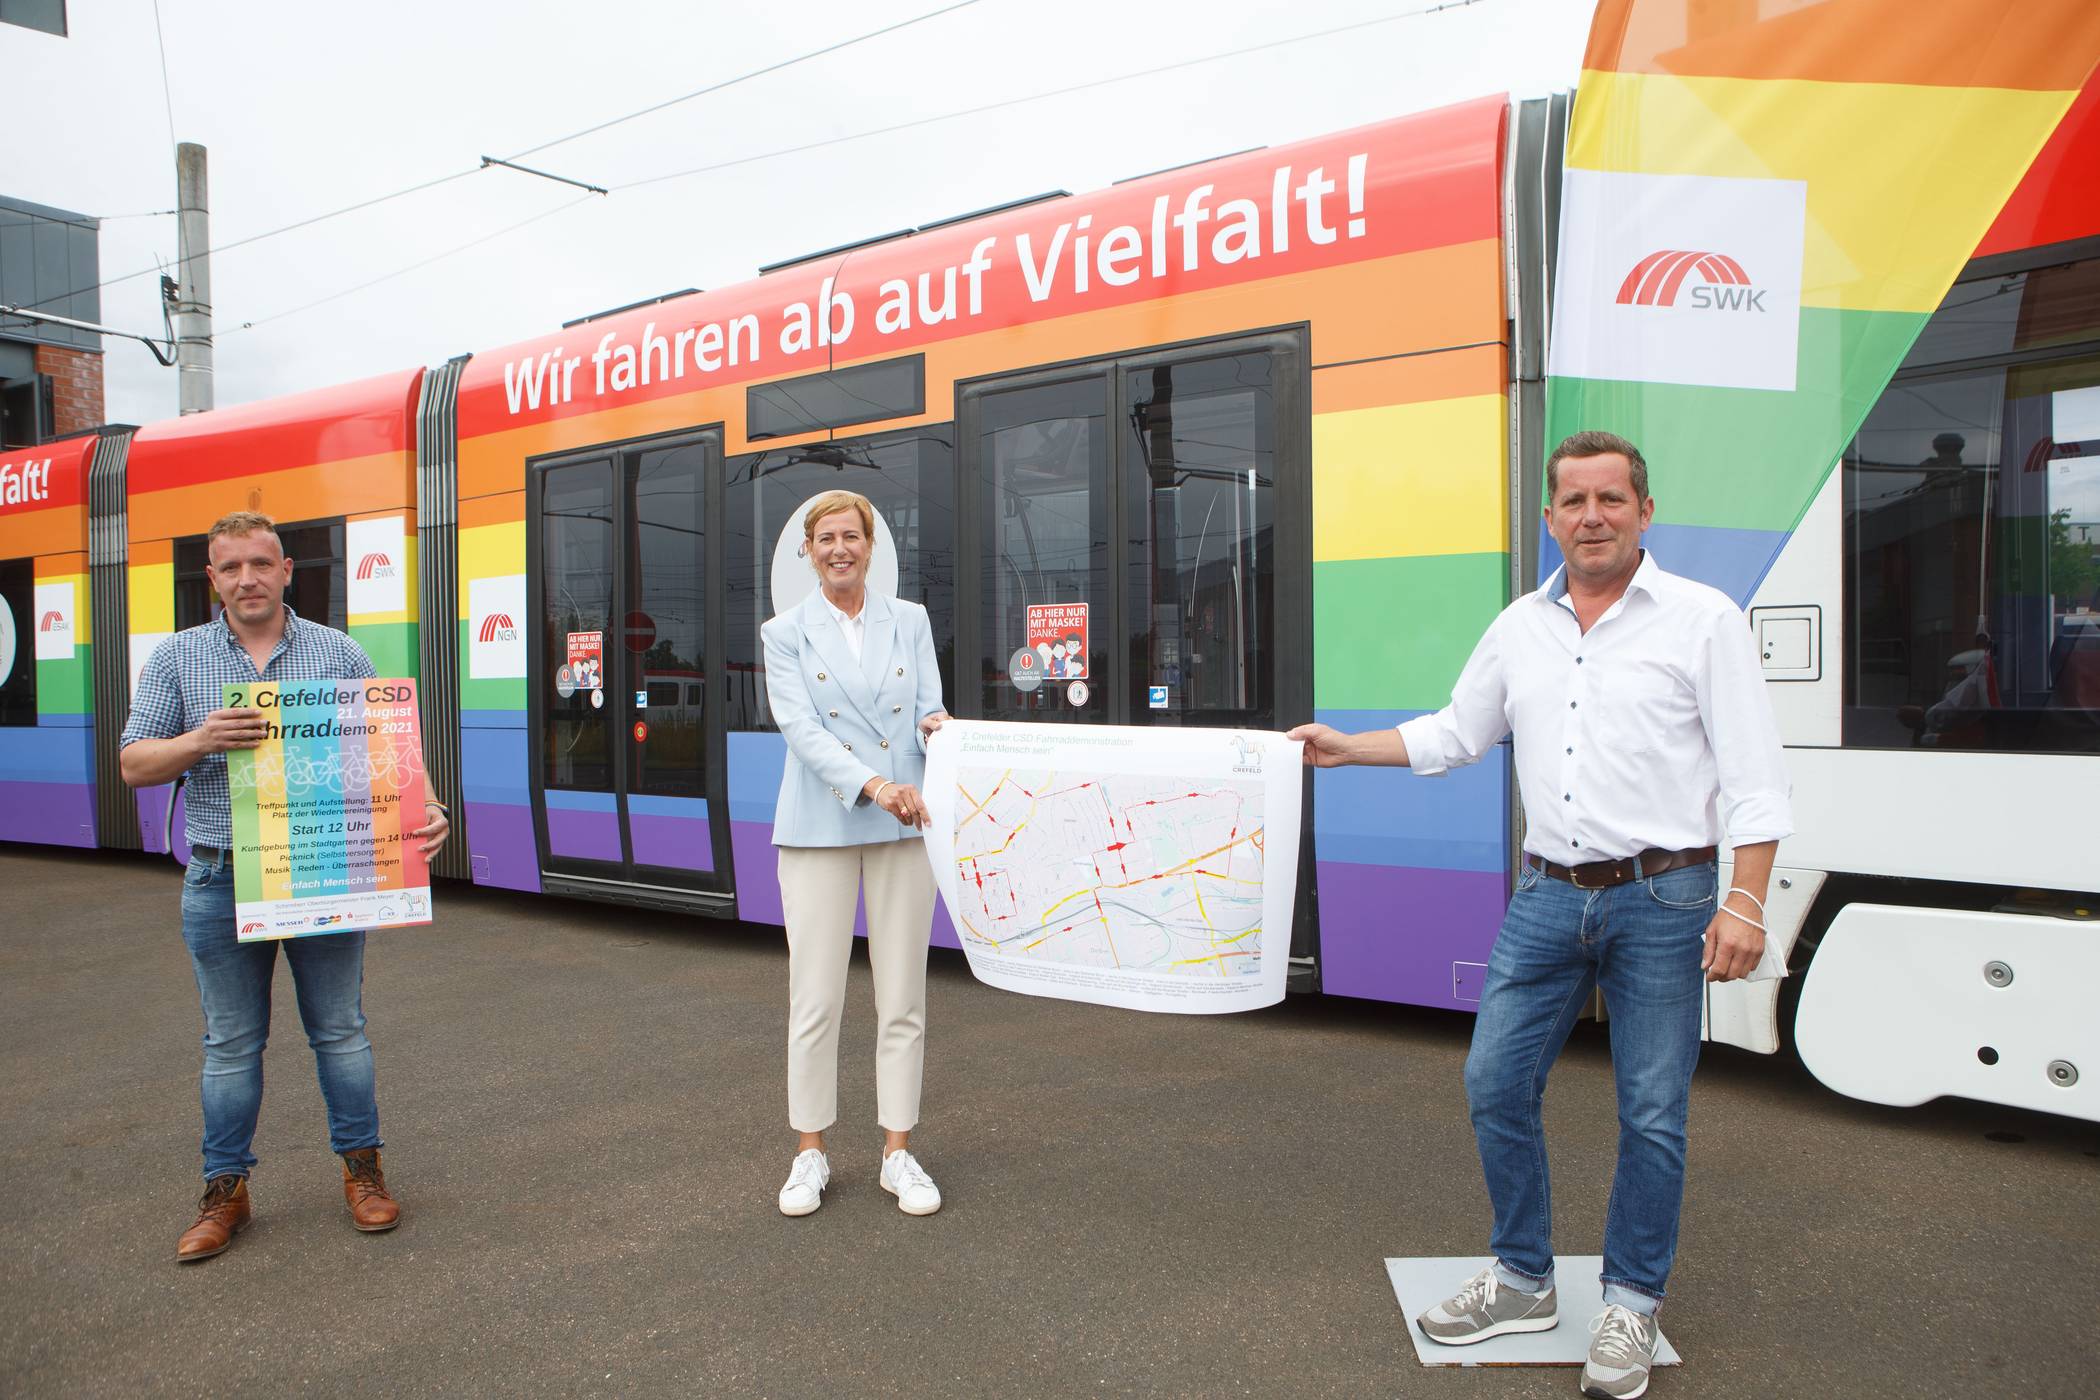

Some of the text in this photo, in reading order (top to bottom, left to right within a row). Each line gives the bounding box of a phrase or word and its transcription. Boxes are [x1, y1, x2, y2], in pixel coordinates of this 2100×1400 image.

[503, 152, 1370, 415] Wir fahren ab auf Vielfalt!
[1691, 286, 1768, 312] SWK
[374, 566, 396, 578] SWK
[1030, 607, 1086, 619] AB HIER NUR
[1030, 617, 1083, 628] MIT MASKE!
[497, 629, 517, 641] NGN
[569, 635, 577, 643] AB
[1030, 628, 1061, 639] DANKE.
[579, 642, 600, 650] MASKE!
[229, 686, 412, 708] 2. Crefelder CSD
[336, 706, 413, 720] 21. August
[258, 718, 413, 740] hrraddemo 2021
[960, 732, 1134, 748] 2. Crefelder CSD Fahrraddemonstration
[996, 744, 1031, 755] Mensch
[256, 794, 403, 811] Treffpunkt und Aufstellung: 11 Uhr
[272, 805, 388, 819] Platz der Wiedervereinigung
[292, 821, 371, 836] Start 12 Uhr
[241, 832, 419, 853] Kundgebung im Stadtgarten gegen 14 Uhr
[279, 848, 385, 862] Picknick (Selbstversorger)
[265, 866, 290, 874] Musik
[297, 864, 325, 873] Reden
[332, 858, 400, 870] Überraschungen
[281, 874, 388, 891] Einfach Mensch sein
